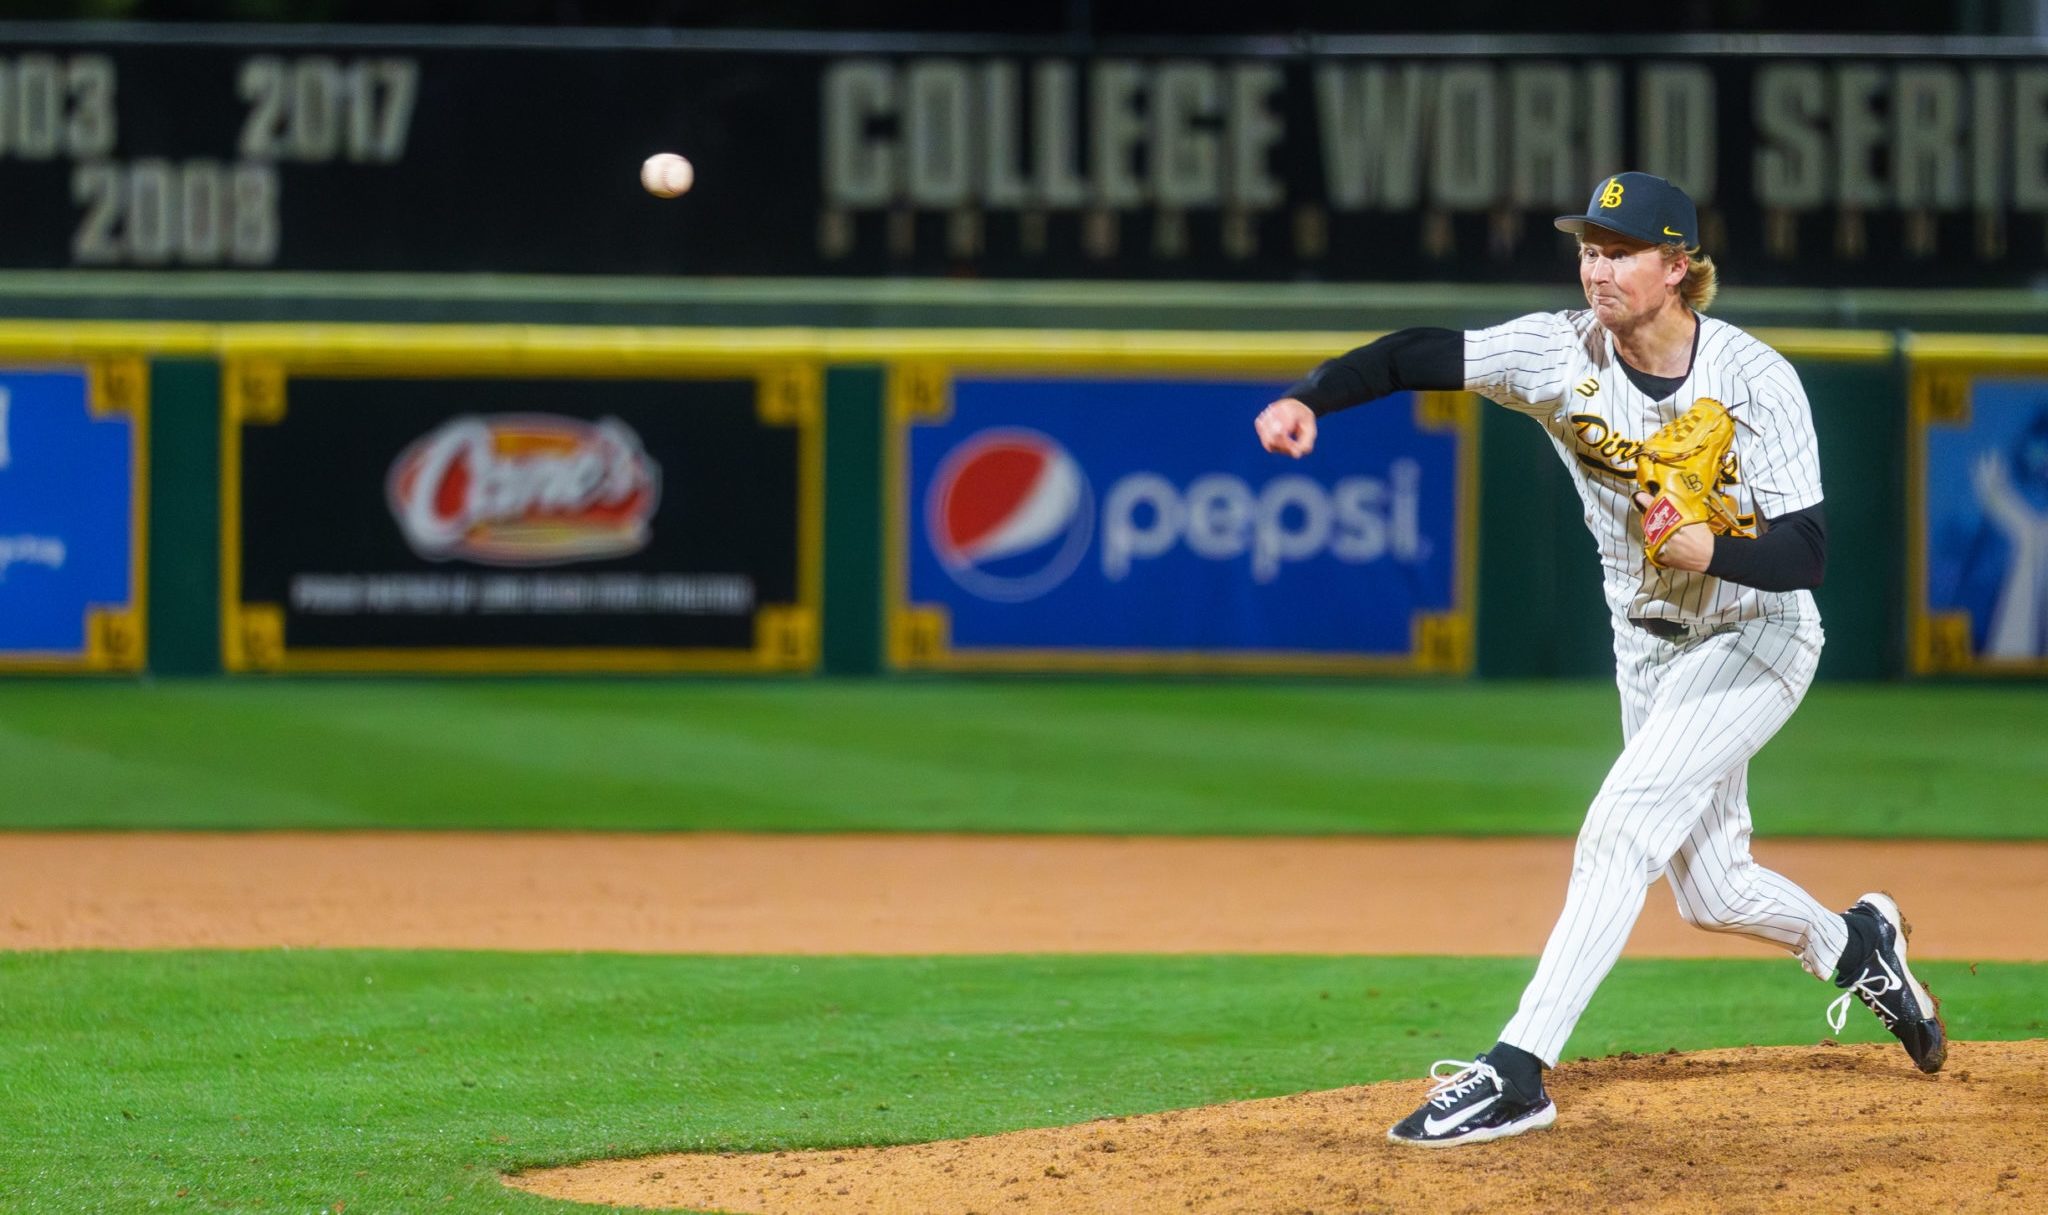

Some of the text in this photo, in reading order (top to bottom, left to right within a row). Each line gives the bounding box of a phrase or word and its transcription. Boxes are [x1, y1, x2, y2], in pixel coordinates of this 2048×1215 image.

[238, 55, 420, 163] 2017
[824, 59, 1285, 208] COLLEGE
[72, 160, 282, 265] 2008
[1102, 458, 1420, 583] pepsi
